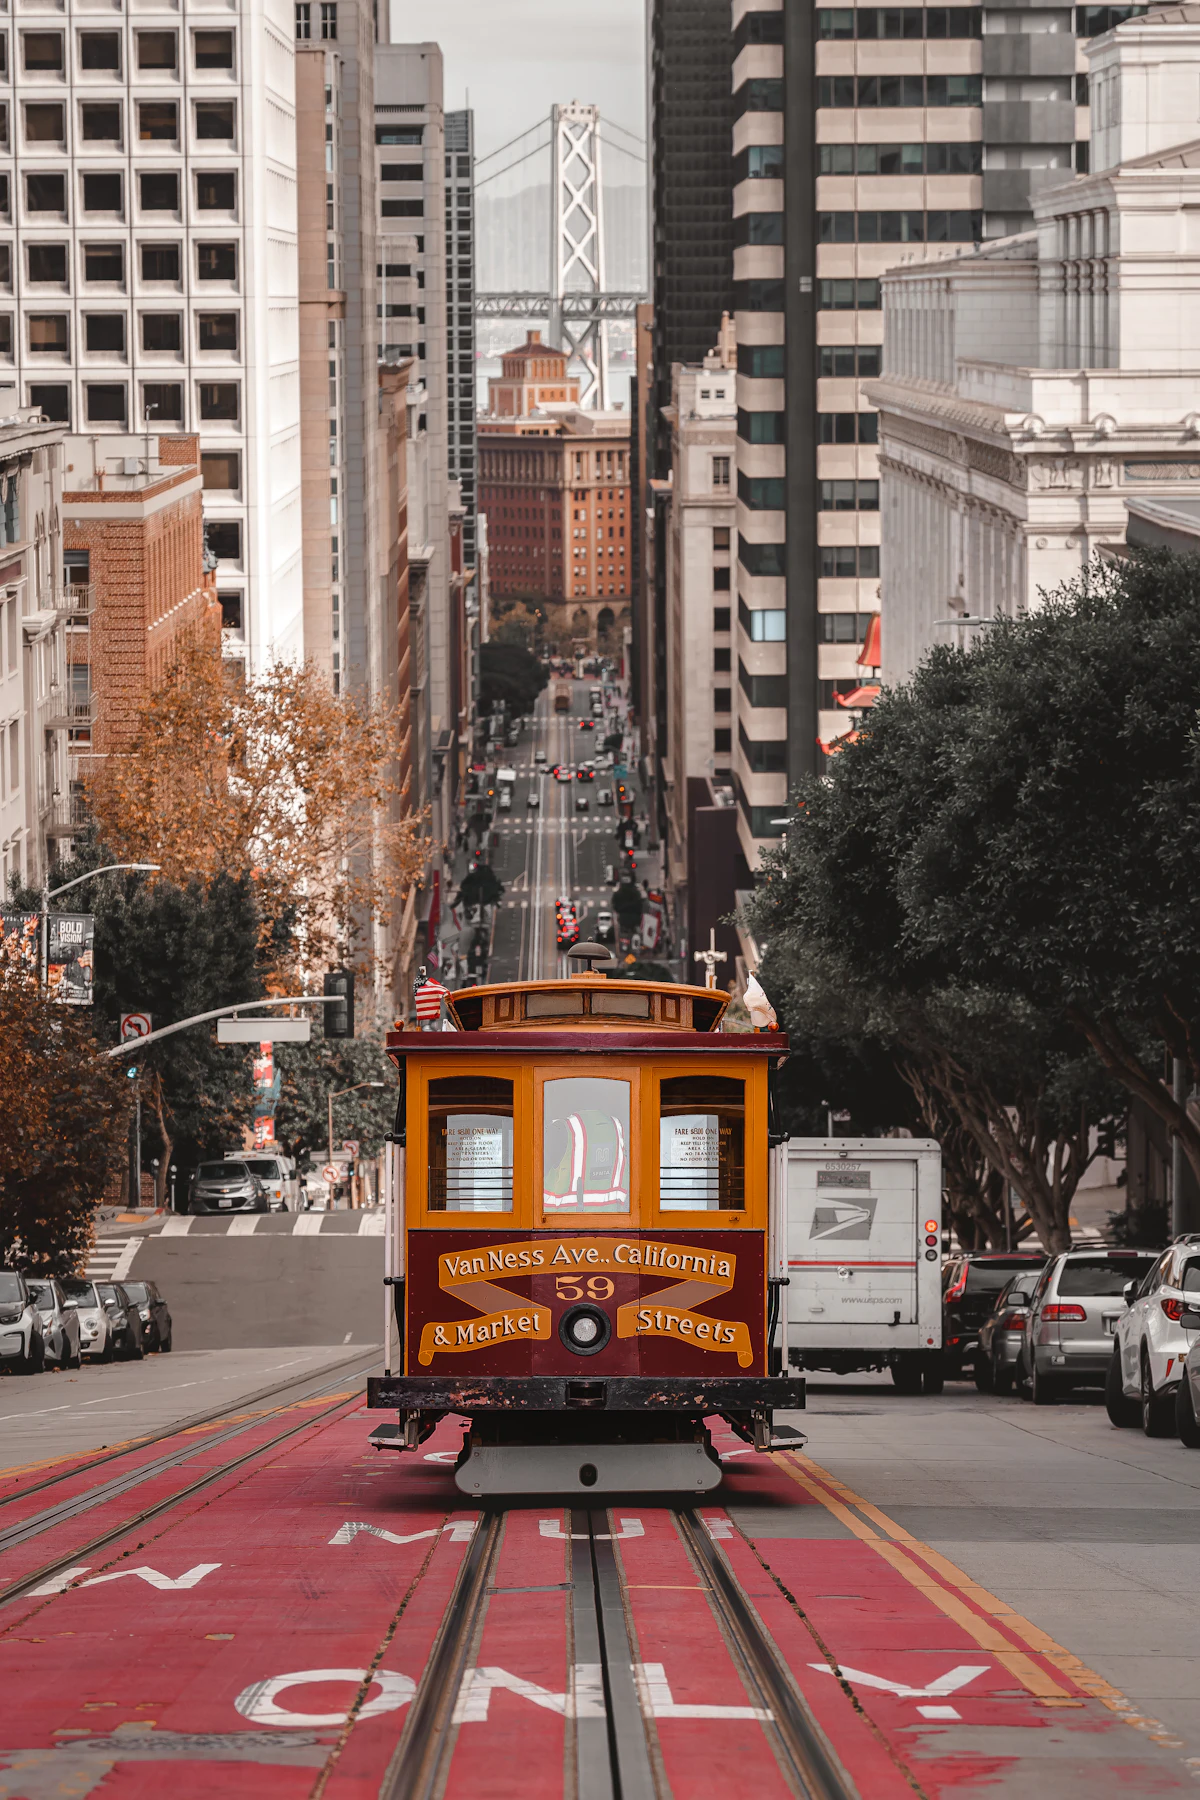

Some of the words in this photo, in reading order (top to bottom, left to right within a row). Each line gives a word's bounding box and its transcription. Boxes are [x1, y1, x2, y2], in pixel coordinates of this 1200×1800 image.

[60, 921, 83, 933] BOLD
[60, 933, 83, 944] VISION
[825, 1162, 861, 1171] 6530257
[444, 1256, 486, 1278] Van
[487, 1249, 545, 1271] Ness
[613, 1244, 731, 1278] California
[556, 1276, 615, 1301] 59
[841, 1296, 903, 1305] www.usps.com
[434, 1325, 451, 1346] &
[454, 1312, 541, 1345] Market
[636, 1309, 736, 1344] Streets
[232, 1663, 992, 1727] ONLY
